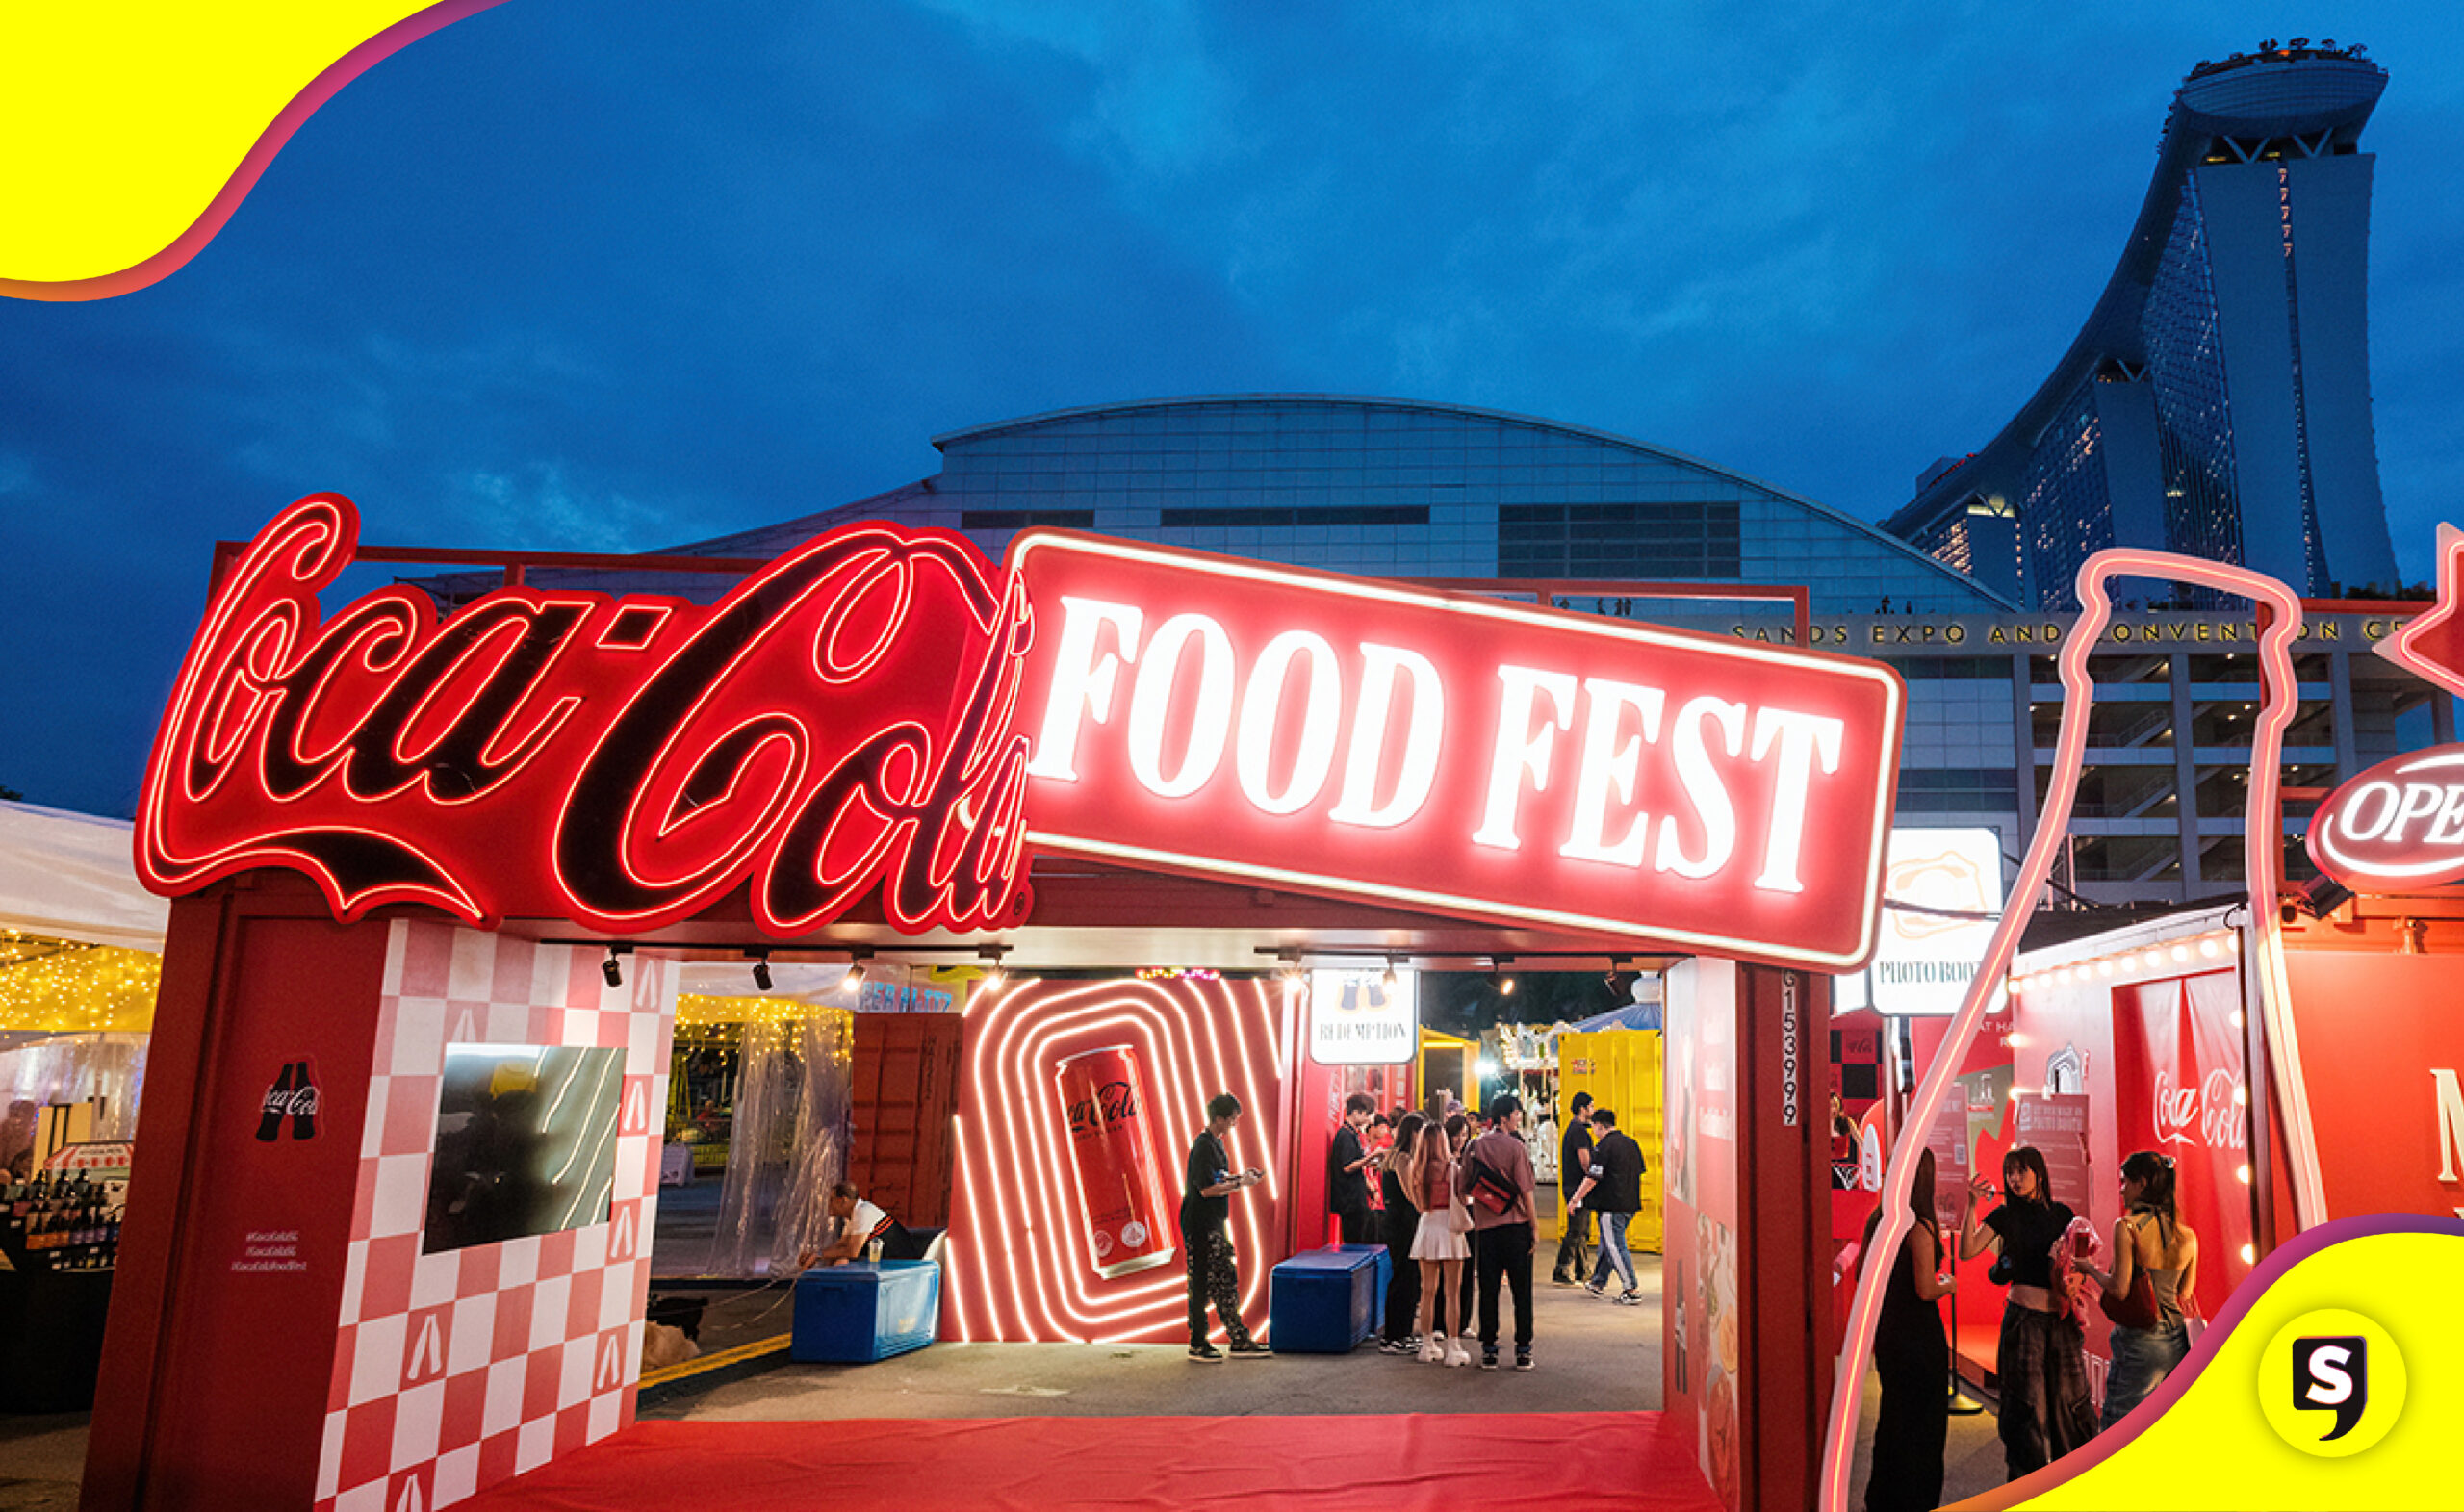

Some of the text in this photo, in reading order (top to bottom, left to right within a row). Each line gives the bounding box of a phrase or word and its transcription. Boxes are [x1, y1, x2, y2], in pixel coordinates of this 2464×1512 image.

[1732, 624, 1848, 644] SANDS
[1872, 624, 1964, 644] EXPO
[1989, 623, 2062, 644] AND
[2099, 621, 2340, 644] ONVENTON
[1027, 595, 1845, 893] FOOD FEST
[1879, 961, 1937, 984] PHOTO
[1320, 1023, 1407, 1041] REDEMPTION
